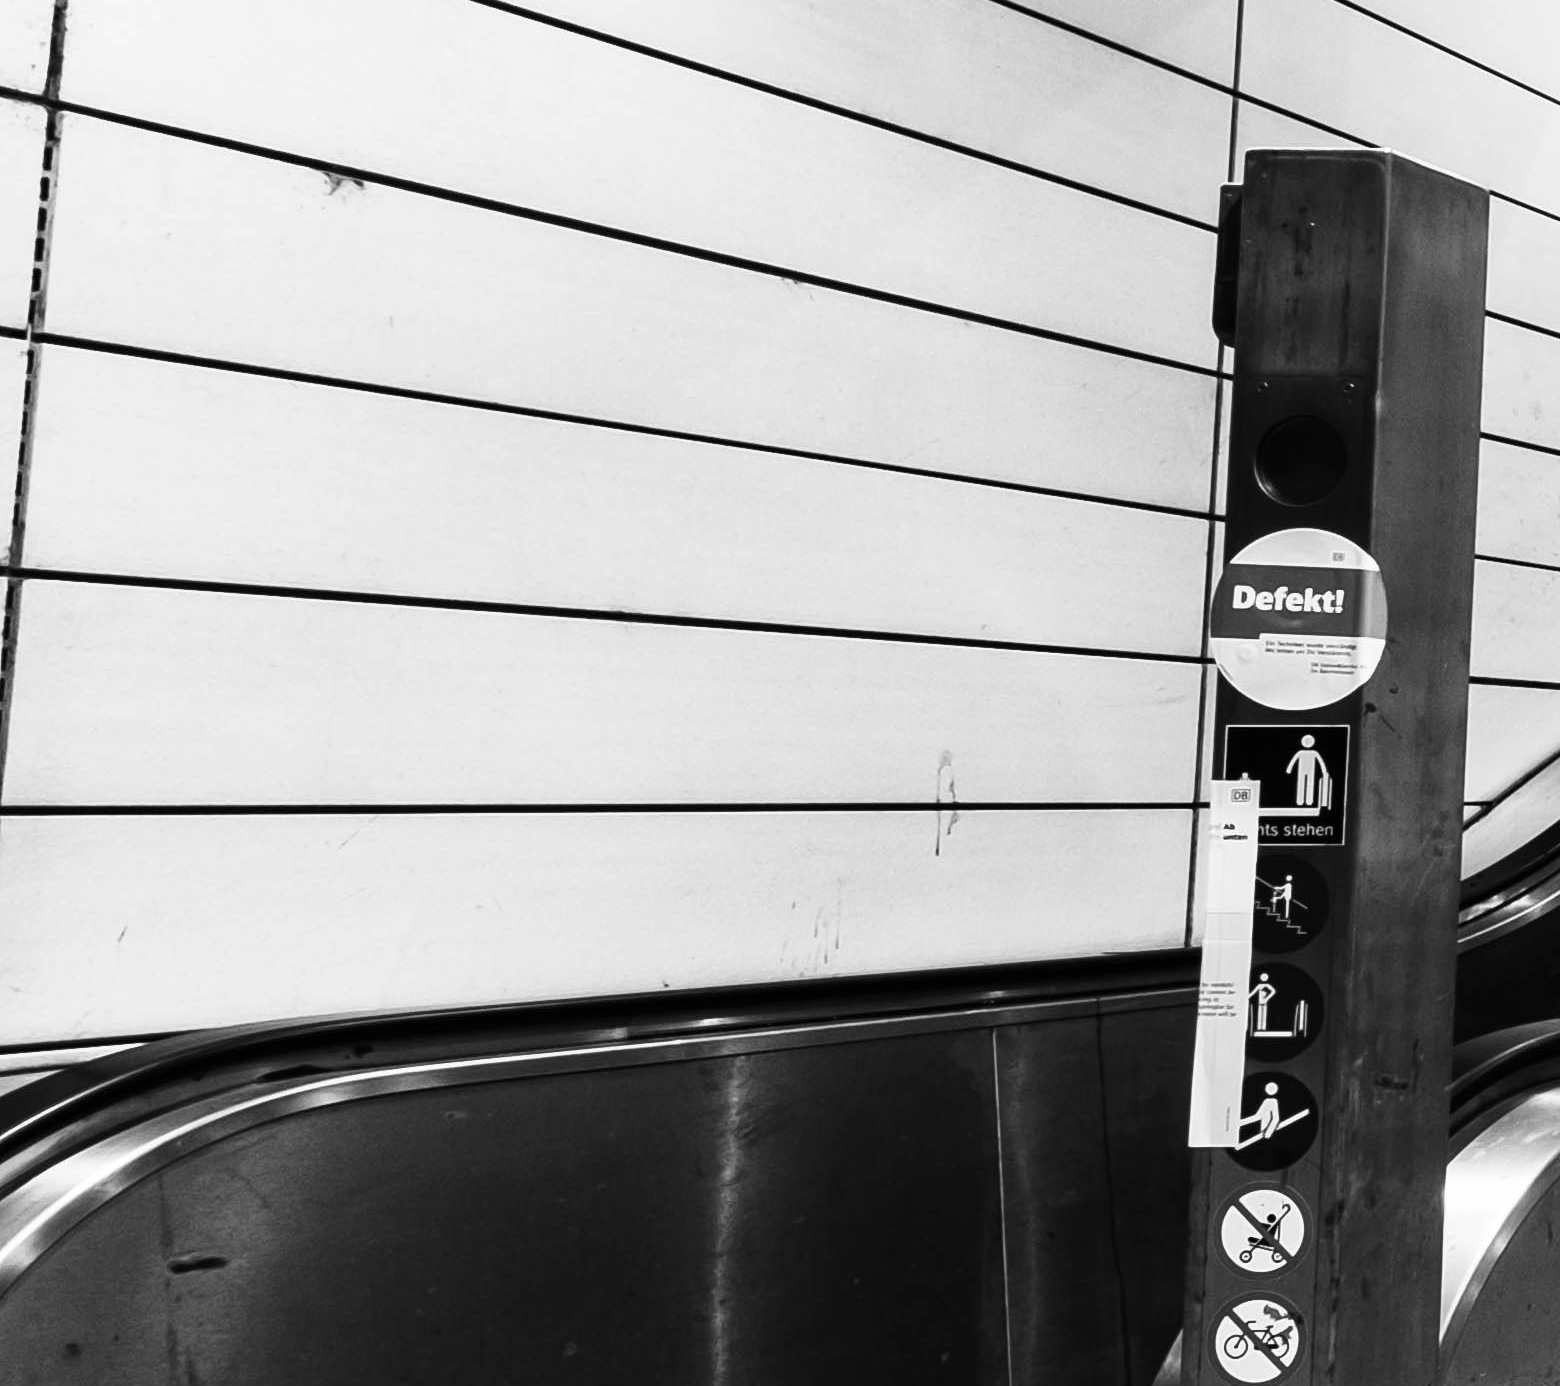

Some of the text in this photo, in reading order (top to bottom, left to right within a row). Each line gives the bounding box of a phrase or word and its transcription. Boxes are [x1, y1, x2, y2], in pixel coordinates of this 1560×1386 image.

[1232, 584, 1345, 614] Defekt!
[1233, 791, 1248, 800] DB
[1283, 823, 1334, 837] stehen
